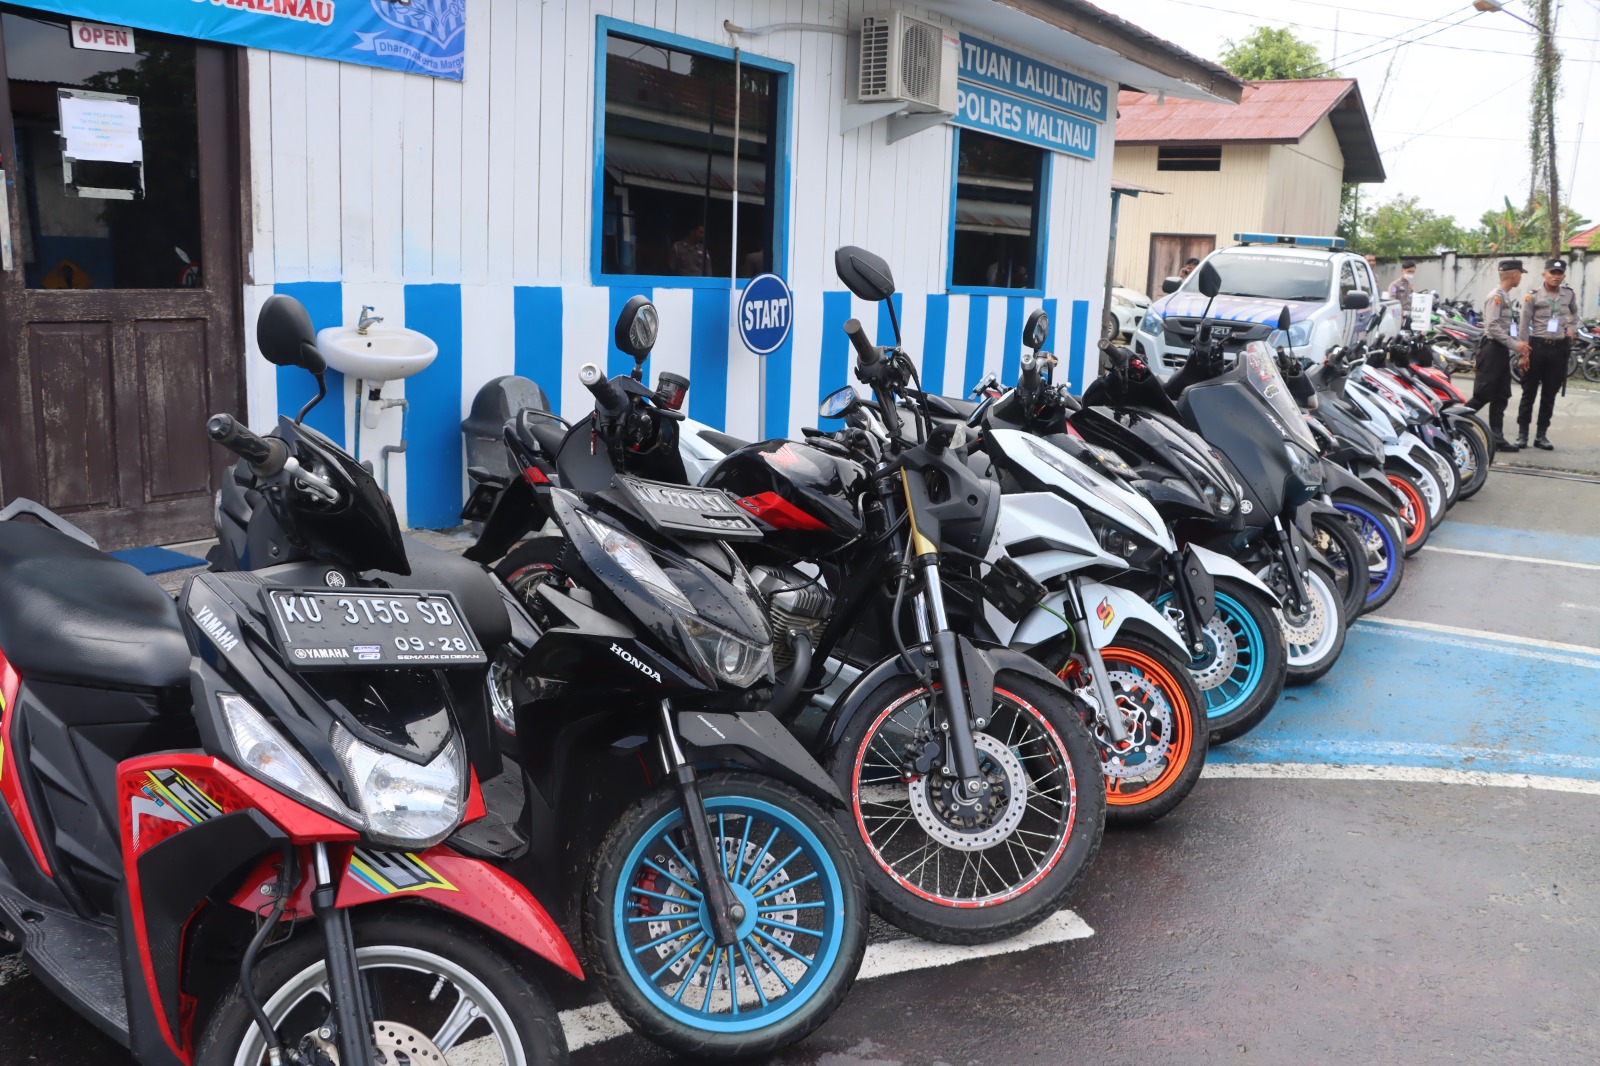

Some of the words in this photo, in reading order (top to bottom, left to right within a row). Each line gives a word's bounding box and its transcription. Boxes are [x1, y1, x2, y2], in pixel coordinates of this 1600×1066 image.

[78, 26, 128, 46] OPEN
[1016, 60, 1102, 113] LALULINTAS
[956, 89, 1022, 132] POLRES
[1026, 109, 1091, 151] MALINAU
[744, 298, 788, 331] START
[196, 605, 239, 652] YAMAHA
[279, 596, 322, 623] KU
[338, 599, 410, 625] 3156
[416, 601, 453, 626] SB
[305, 649, 350, 659] YAMAHA
[609, 642, 662, 684] HONDA
